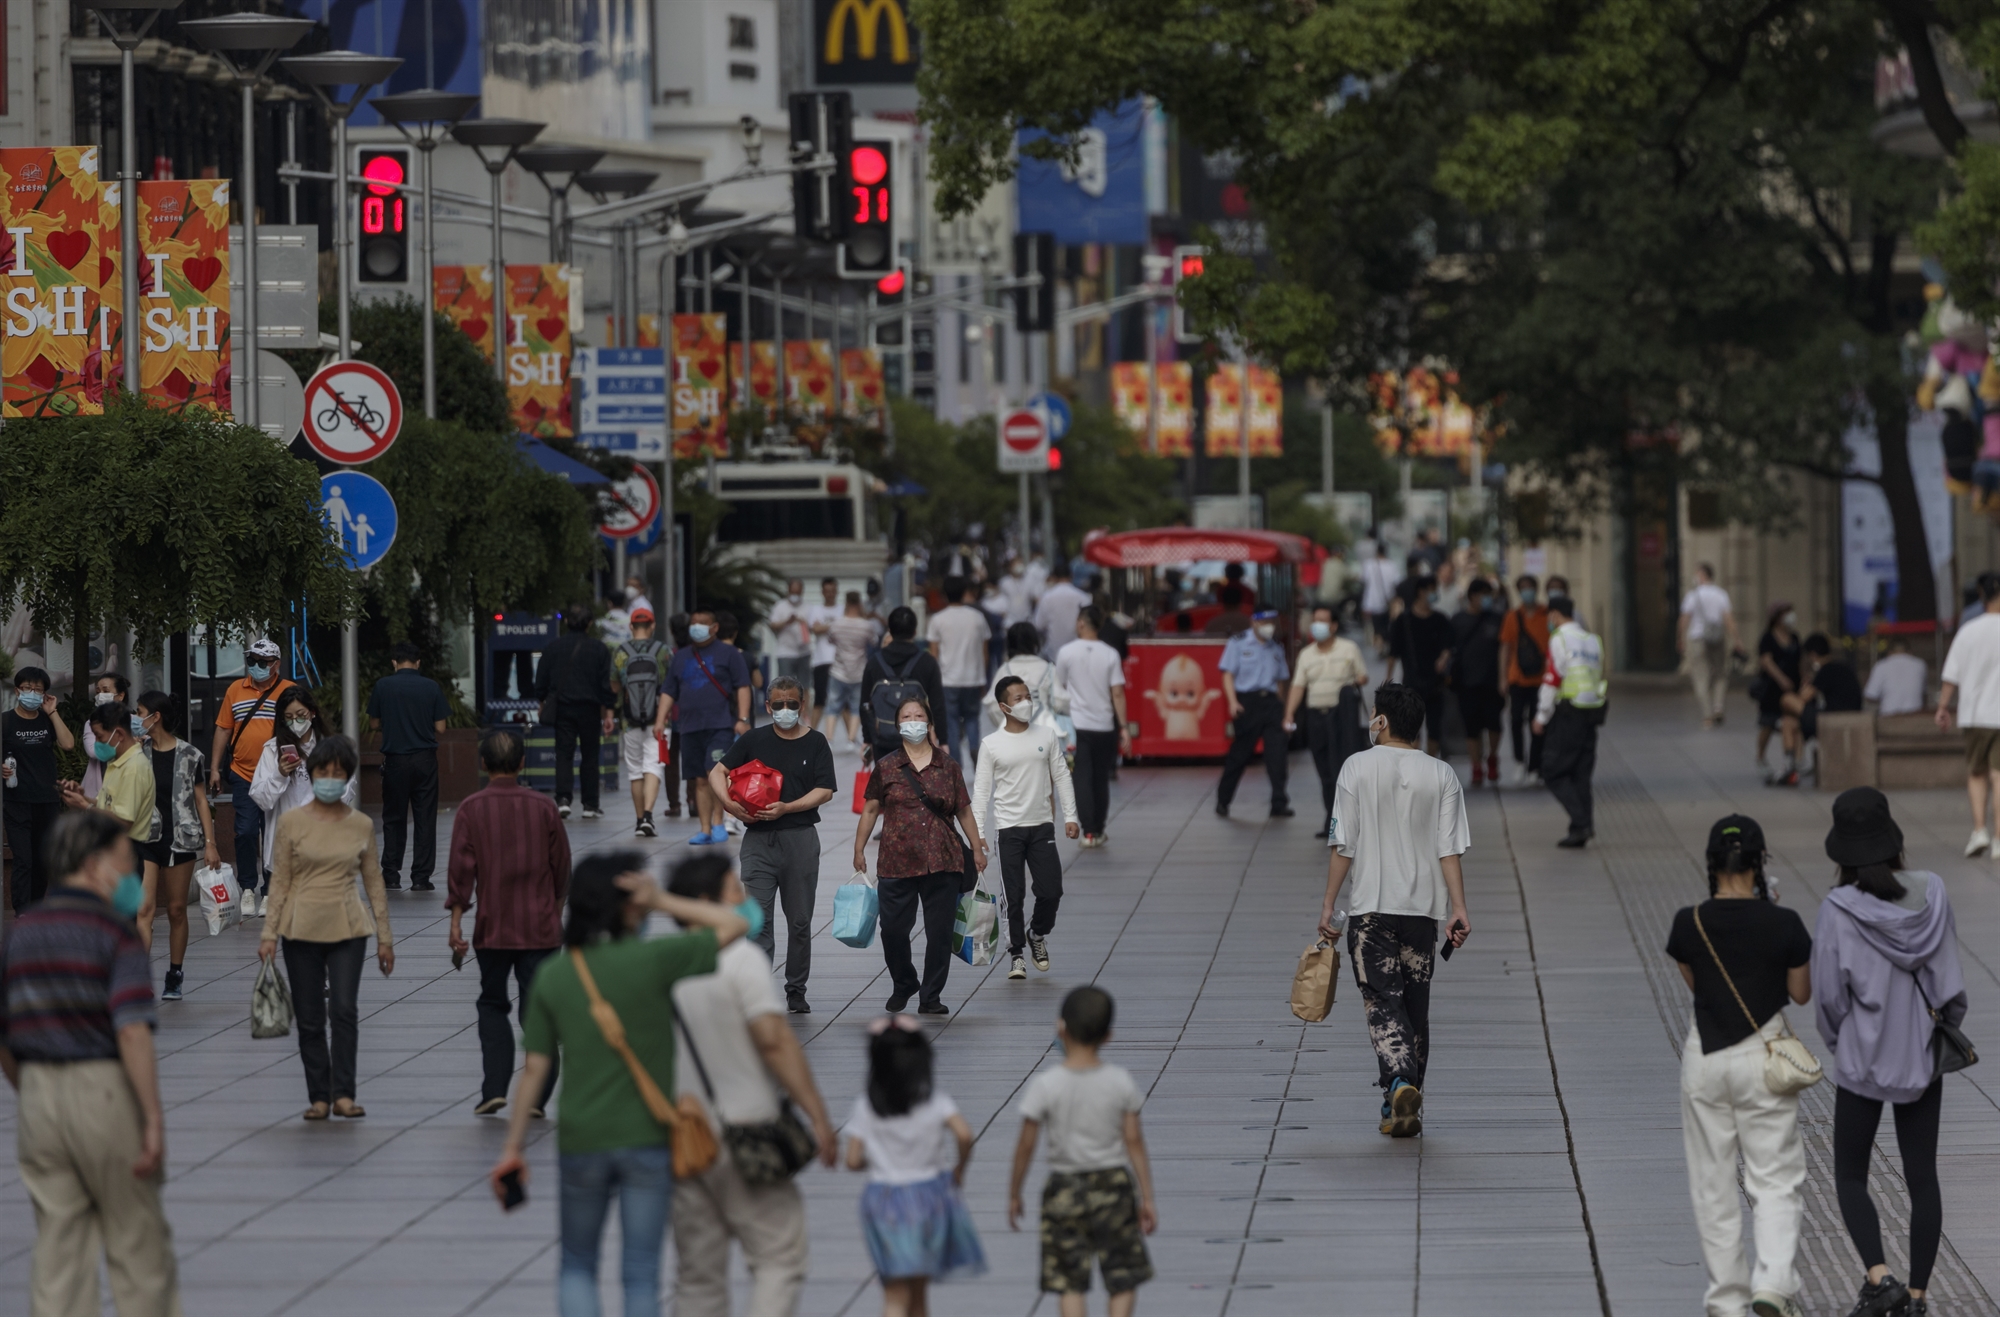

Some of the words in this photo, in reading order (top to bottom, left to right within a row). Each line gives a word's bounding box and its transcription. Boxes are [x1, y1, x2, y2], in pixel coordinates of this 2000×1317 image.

[364, 197, 403, 234] 01
[7, 227, 34, 277] I
[147, 253, 171, 298] I
[6, 286, 88, 337] SH
[145, 306, 219, 353] SH
[510, 314, 528, 348] I
[509, 352, 563, 387] SH
[676, 356, 692, 385] I
[674, 387, 721, 417] SH
[507, 624, 537, 635] POLICE
